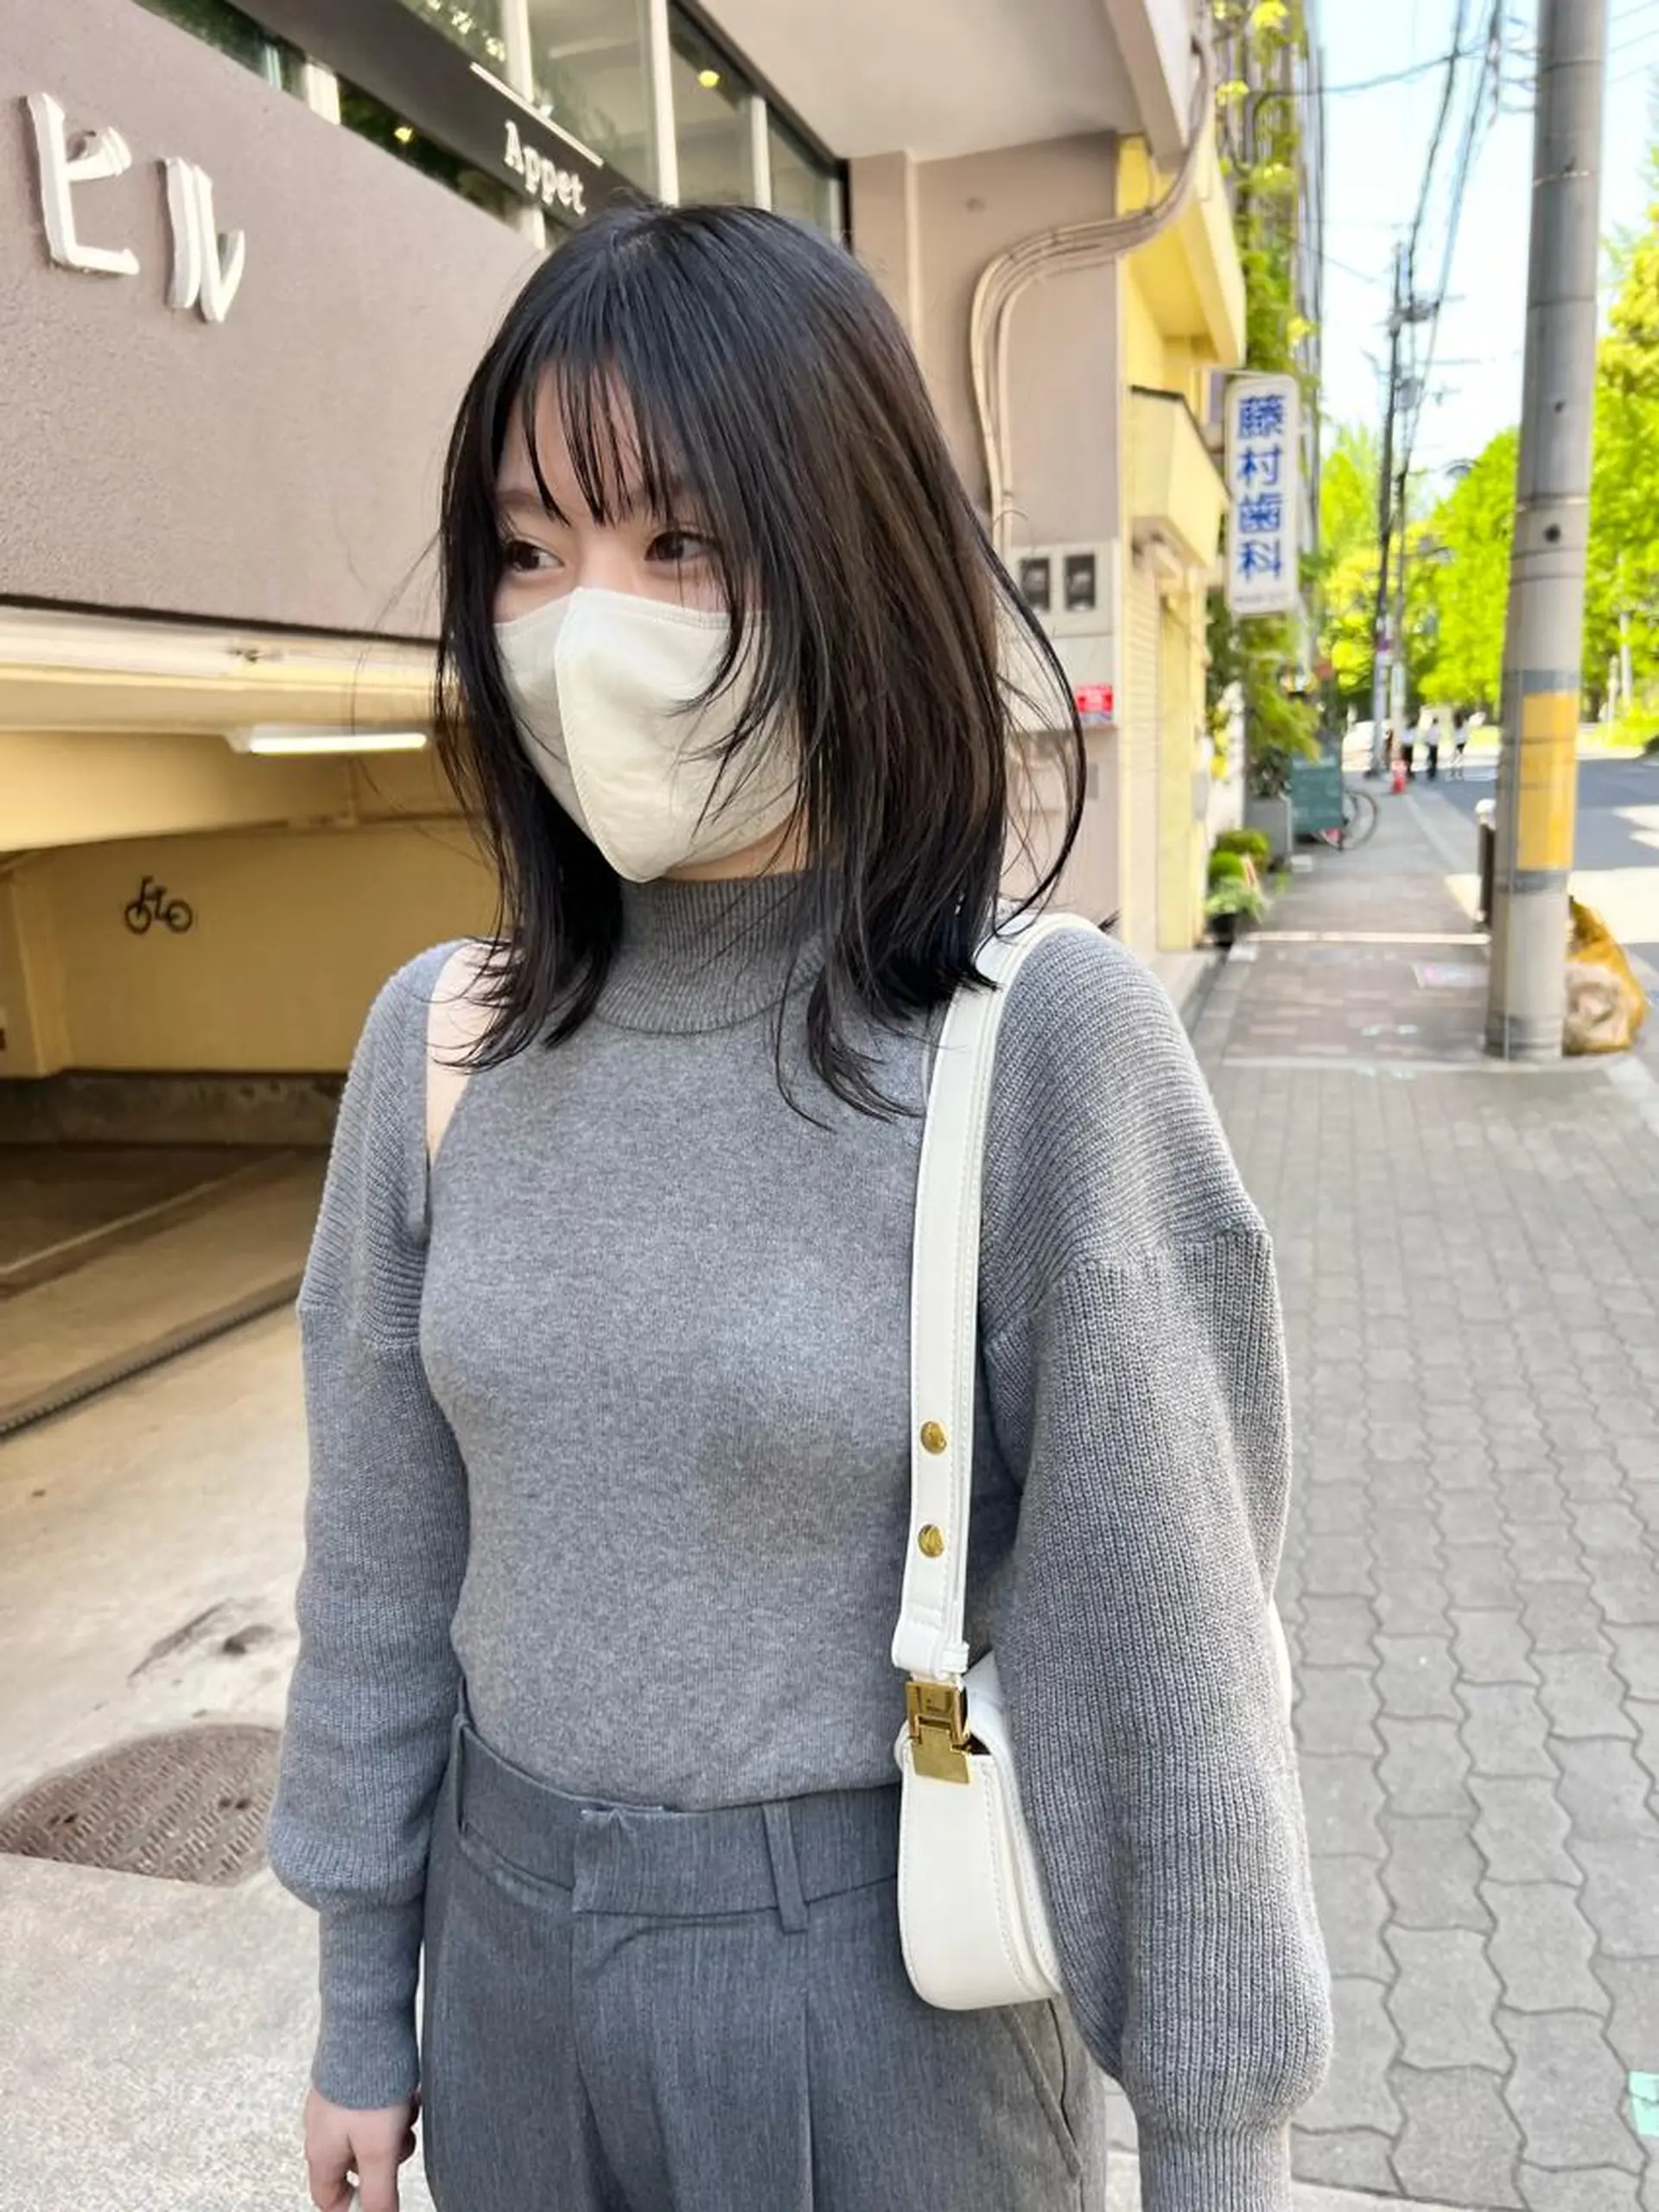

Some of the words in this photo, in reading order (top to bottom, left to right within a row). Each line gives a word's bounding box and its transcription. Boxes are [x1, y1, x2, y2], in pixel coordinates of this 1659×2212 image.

[504, 119, 587, 216] Appet
[1236, 394, 1283, 582] 藤村歯科
